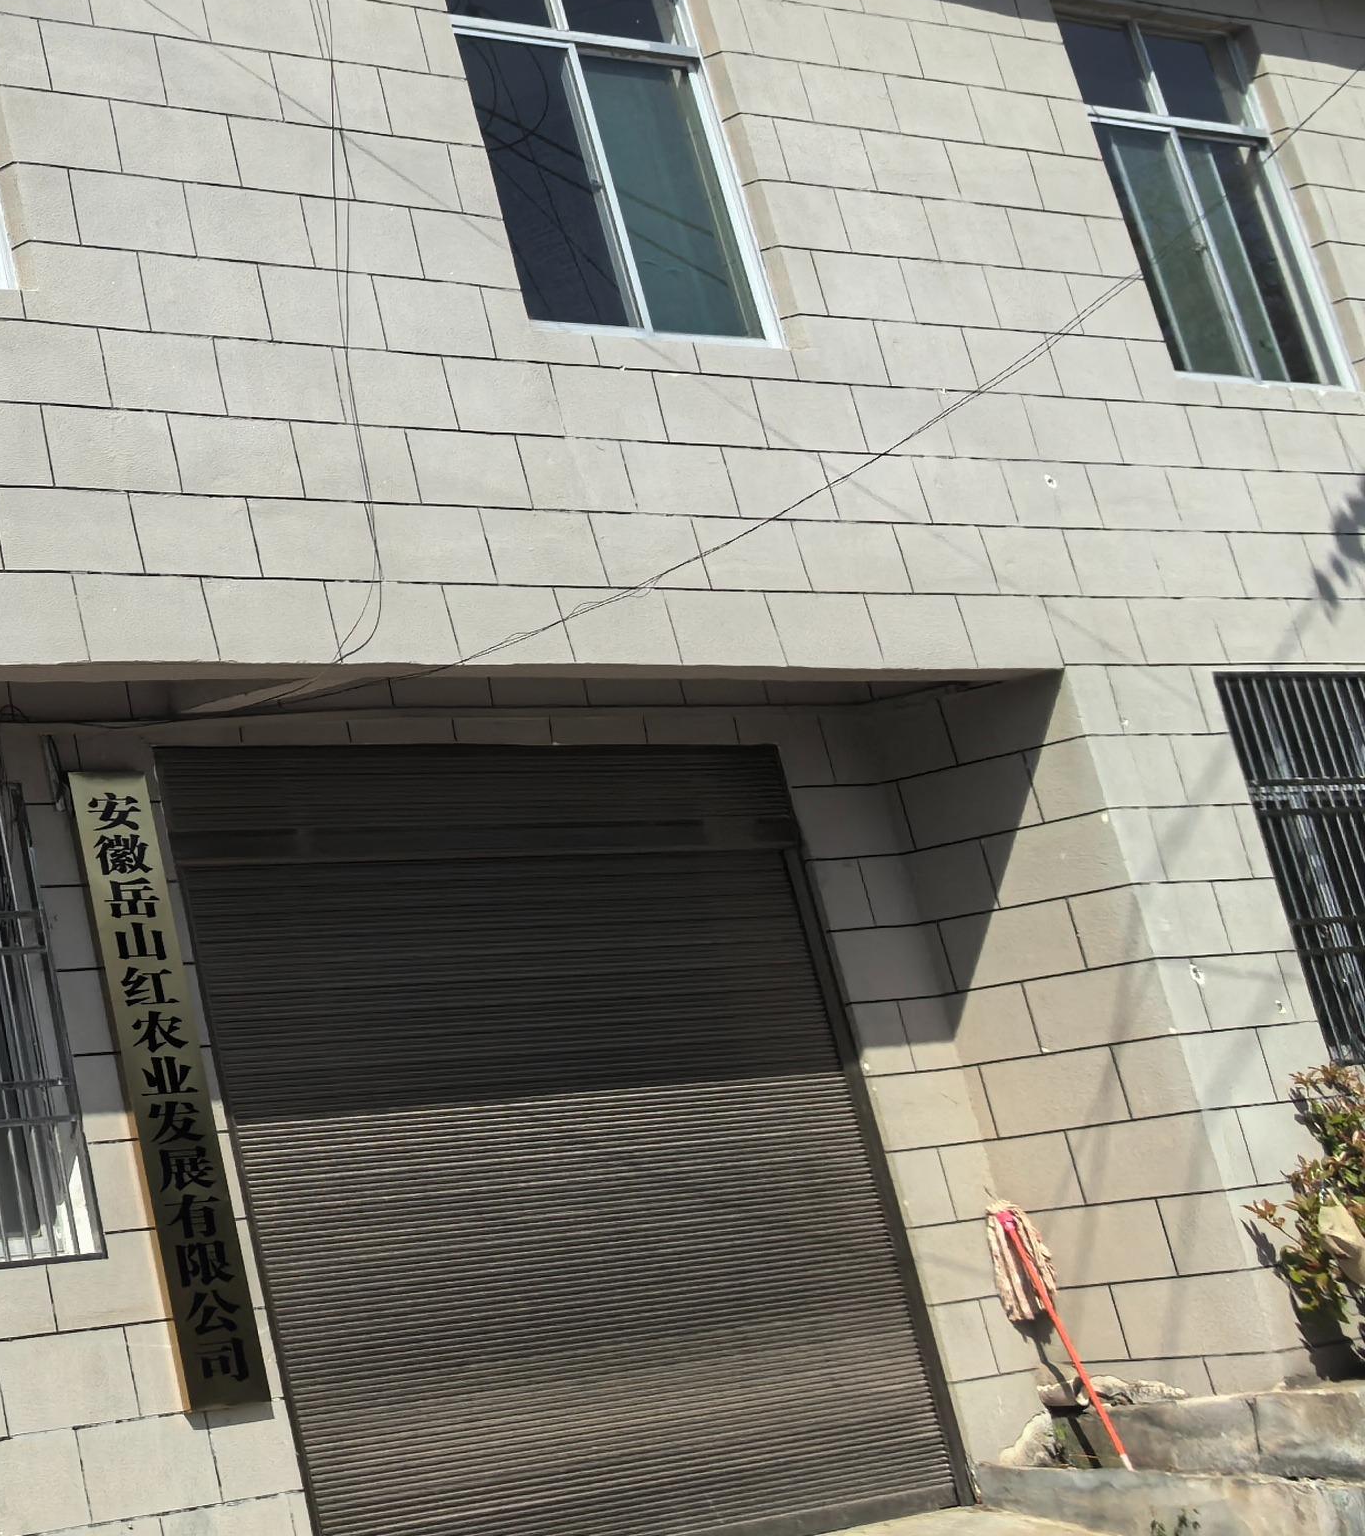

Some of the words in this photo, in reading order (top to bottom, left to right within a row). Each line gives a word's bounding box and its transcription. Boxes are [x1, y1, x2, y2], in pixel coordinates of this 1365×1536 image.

[87, 792, 250, 1383] 安徽岳山红农业发展有限公司
